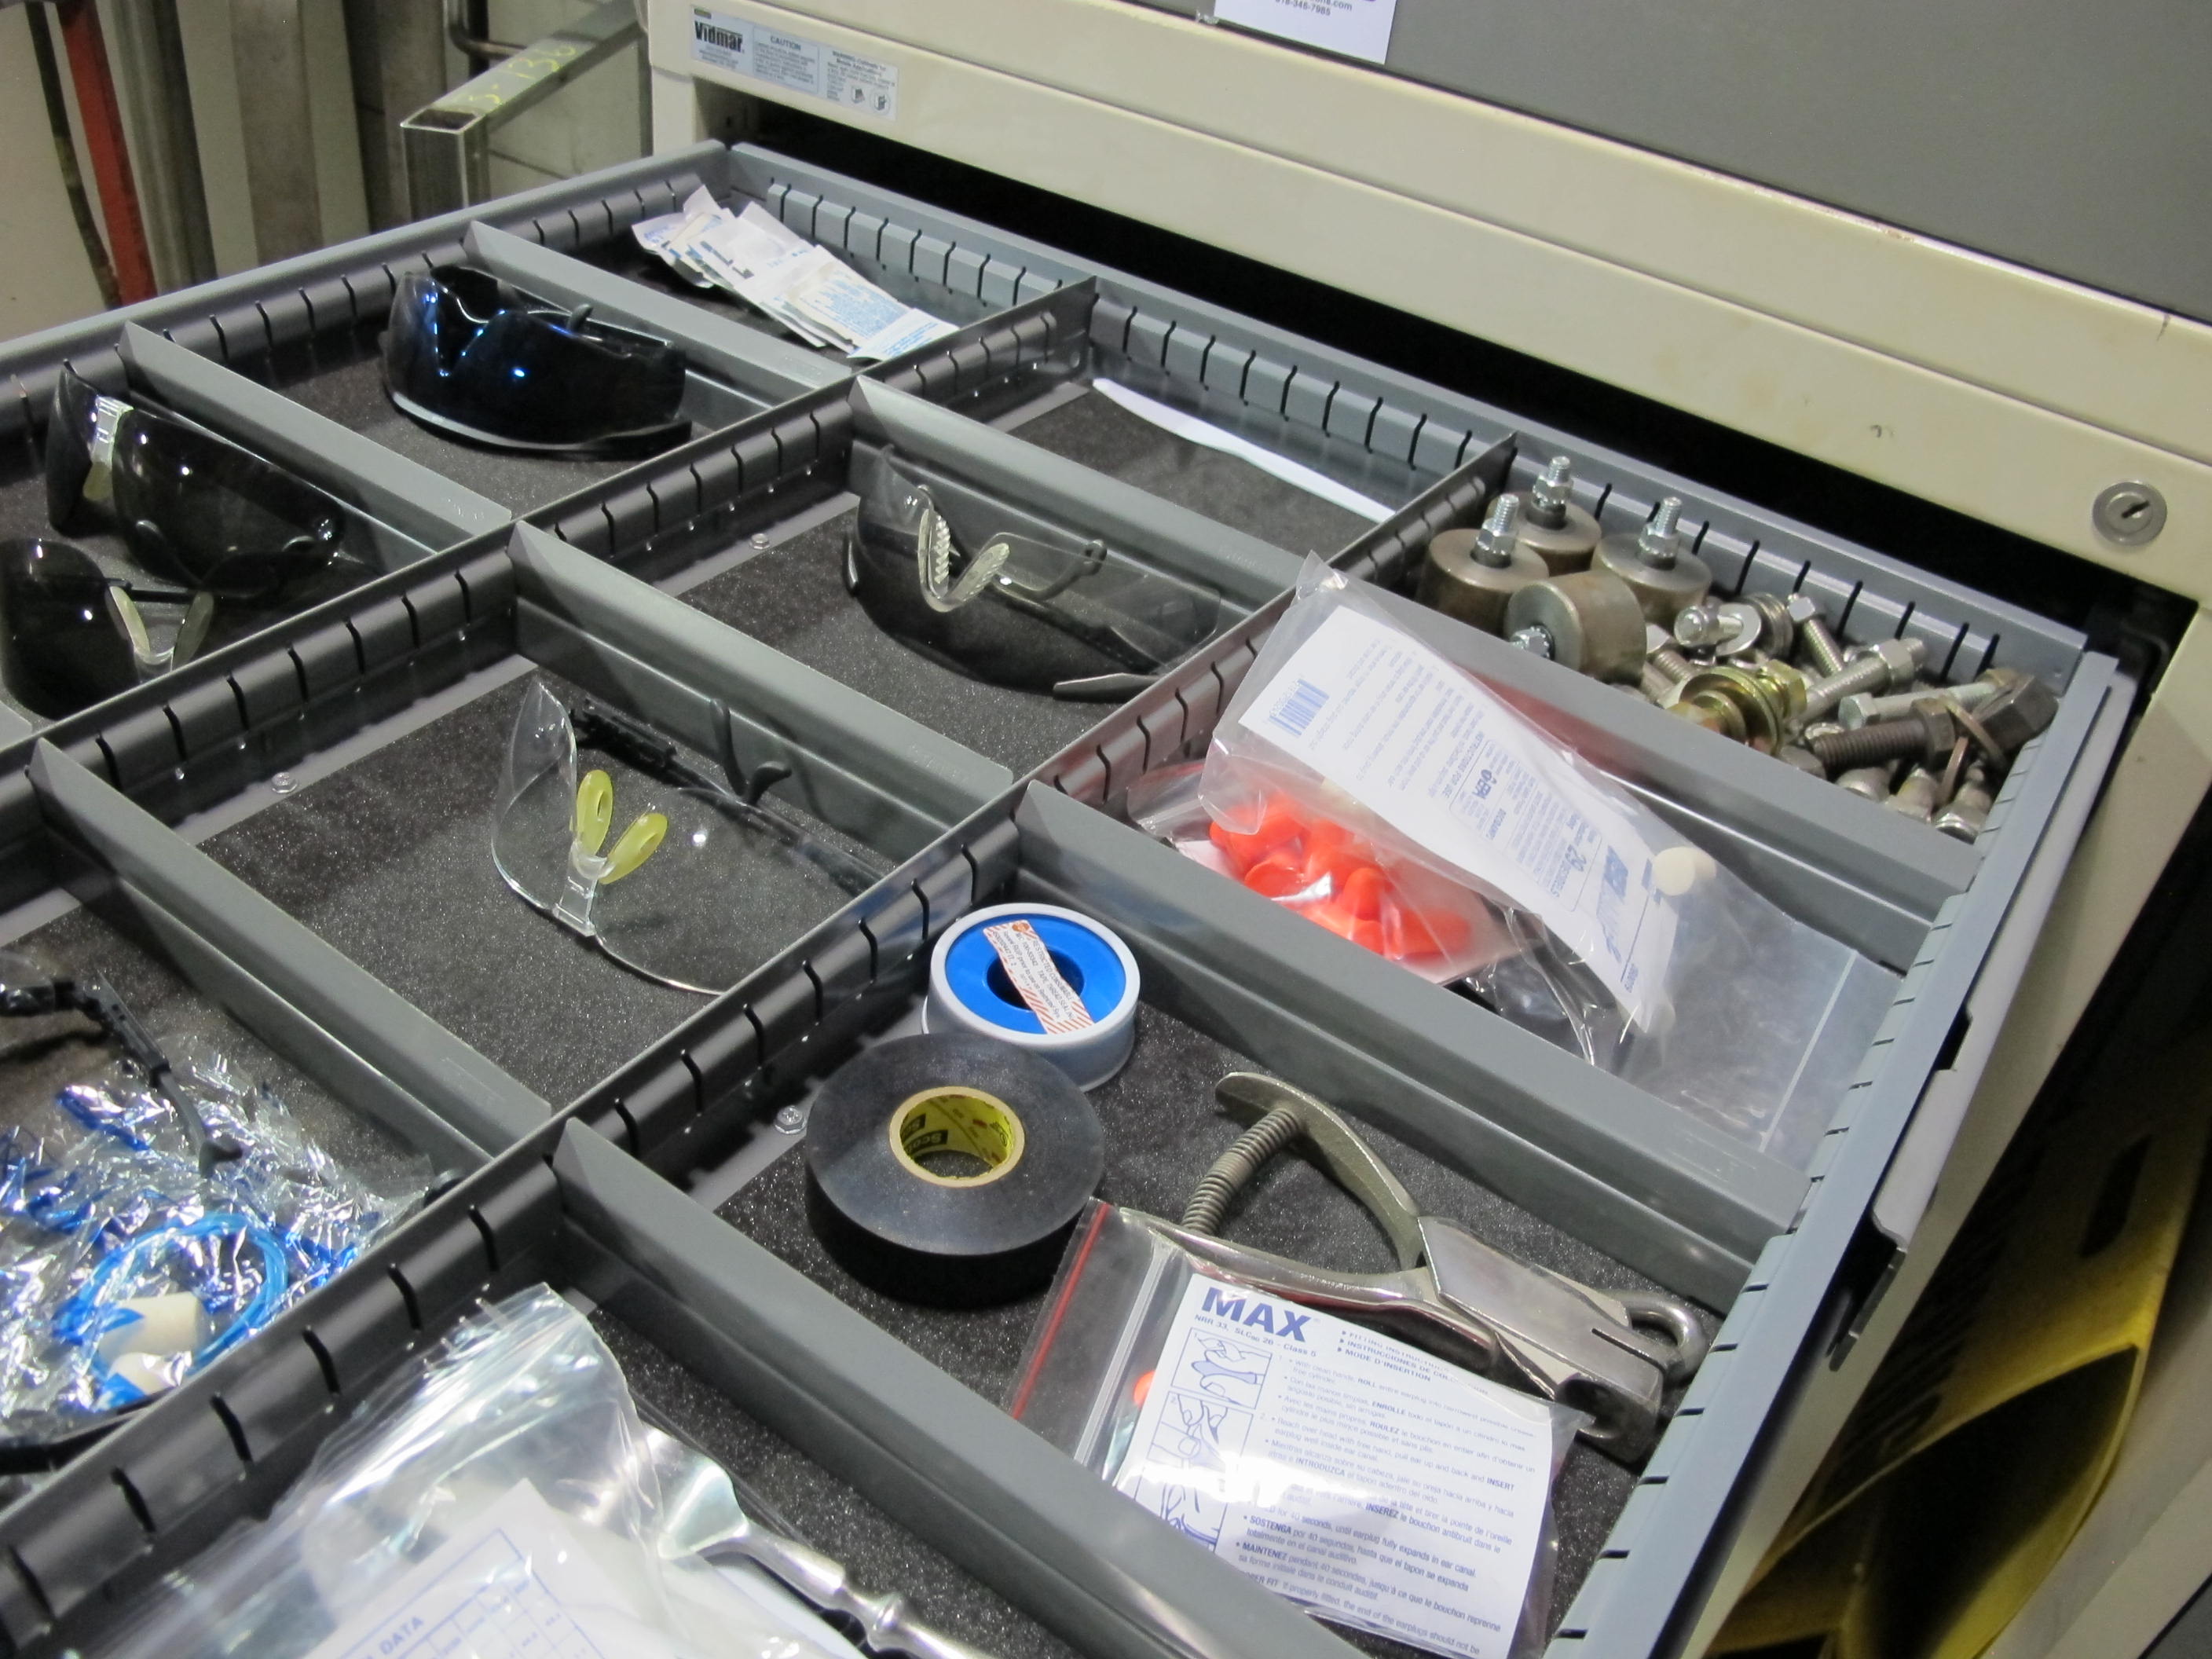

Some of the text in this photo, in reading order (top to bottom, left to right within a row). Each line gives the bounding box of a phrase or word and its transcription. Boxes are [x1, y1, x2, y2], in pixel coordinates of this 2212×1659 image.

[694, 20, 743, 53] Vidmar
[770, 35, 802, 52] CAUTION
[1202, 1287, 1311, 1342] MAX
[1194, 1314, 1214, 1324] NRR
[1284, 1344, 1308, 1355] Class
[1345, 1349, 1431, 1382] MODE D'INSERTION
[1357, 1378, 1376, 1388] ROLL
[1372, 1401, 1406, 1415] ENROLLE
[1370, 1421, 1400, 1434] ROULEZ
[1410, 1432, 1441, 1446] bouchon
[1271, 1440, 1303, 1454] Mientras
[1444, 1489, 1463, 1502] hacia
[1495, 1506, 1514, 1518] hacia
[1295, 1456, 1346, 1477] INTRODUZCA
[1435, 1463, 1449, 1472] and
[1451, 1467, 1468, 1478] back
[1471, 1474, 1485, 1483] and
[1486, 1478, 1514, 1491] INSERT
[1366, 1503, 1500, 1554] INSEREZ le bouchon antibruit dans le
[1450, 1519, 1473, 1532] pointe
[1474, 1526, 1485, 1535] de
[1247, 1529, 1285, 1545] totalmente
[1287, 1538, 1296, 1547] en
[1307, 1546, 1327, 1556] canal
[1328, 1551, 1357, 1565] auditivo.
[1250, 1515, 1291, 1533] SOSTENGA
[1293, 1529, 1306, 1538] por
[1308, 1533, 1318, 1541] 40
[1319, 1536, 1355, 1553] segundos,
[1357, 1545, 1377, 1558] hasta
[1379, 1553, 1393, 1565] que
[1395, 1558, 1402, 1567] el
[1437, 1574, 1469, 1591] expanda
[1302, 1516, 1333, 1532] seconds,
[1335, 1525, 1352, 1536] until
[1353, 1529, 1380, 1544] earplug
[1382, 1536, 1397, 1551] fully
[1399, 1543, 1430, 1562] expands
[1431, 1555, 1439, 1564] in
[1441, 1558, 1453, 1569] ear
[1455, 1564, 1476, 1578] canal.
[1242, 1542, 1287, 1561] MAINTENEZ
[1288, 1556, 1319, 1570] pendant
[1332, 1566, 1367, 1584] secondes,
[1398, 1590, 1408, 1599] ce
[1409, 1593, 1423, 1605] que
[1425, 1599, 1432, 1607] le
[1434, 1602, 1465, 1620] bouchon
[1467, 1613, 1501, 1632] reprenne
[1249, 1556, 1271, 1569] forme
[1298, 1568, 1316, 1580] dans
[1317, 1574, 1324, 1583] le
[1326, 1576, 1353, 1591] conduit
[1266, 1576, 1278, 1588] FIT
[1343, 1596, 1355, 1610] the
[1357, 1606, 1372, 1617] end
[1373, 1610, 1382, 1618] of
[1382, 1613, 1395, 1624] the
[1396, 1621, 1428, 1636] earplugs
[1430, 1630, 1455, 1646] should
[1456, 1639, 1469, 1651] not
[1470, 1643, 1480, 1654] be
[379, 1616, 424, 1655] DATA
